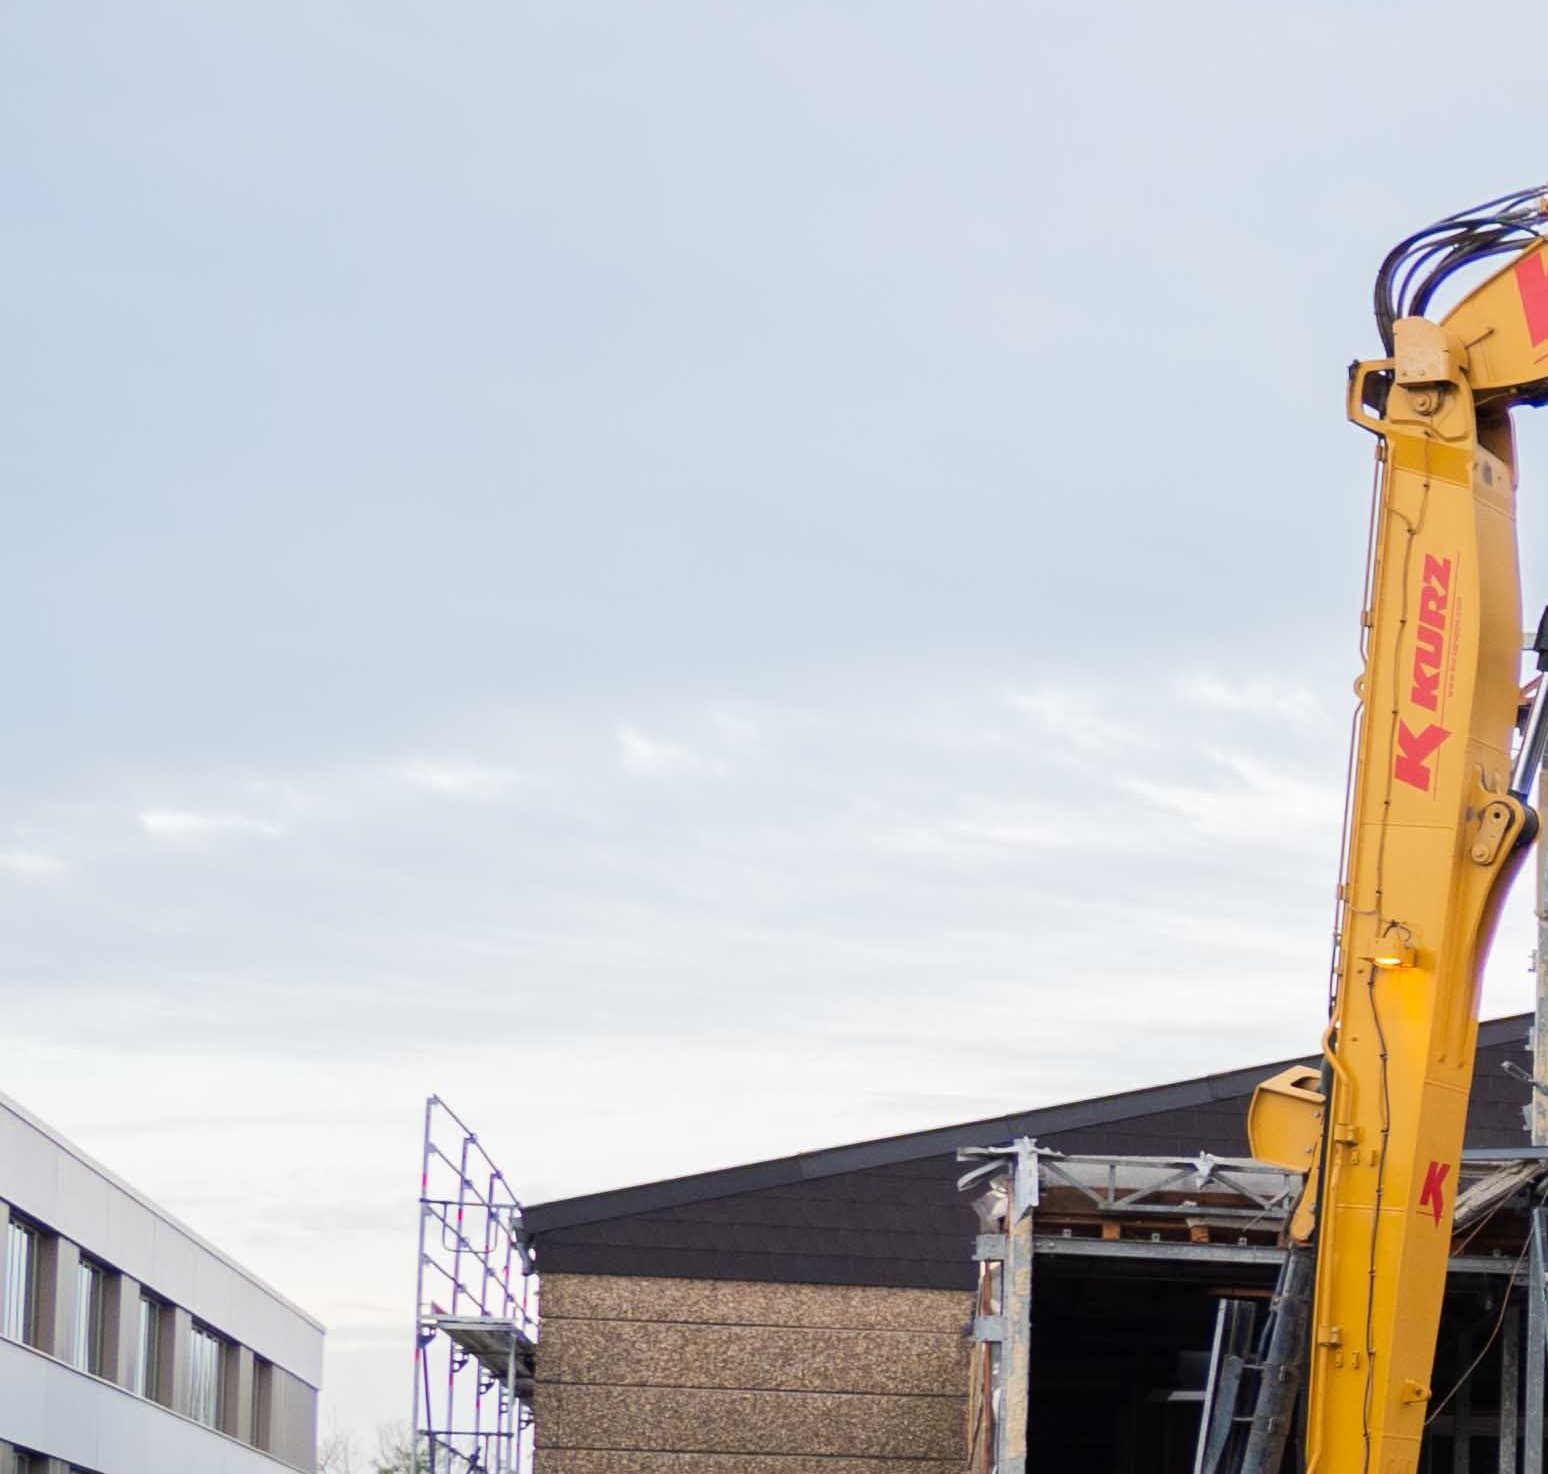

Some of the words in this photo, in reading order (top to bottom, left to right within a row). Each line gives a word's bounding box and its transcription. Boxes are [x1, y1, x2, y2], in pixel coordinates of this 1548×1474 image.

[1410, 552, 1451, 712] KURZ
[1394, 717, 1451, 793] K
[1419, 1160, 1451, 1229] K
